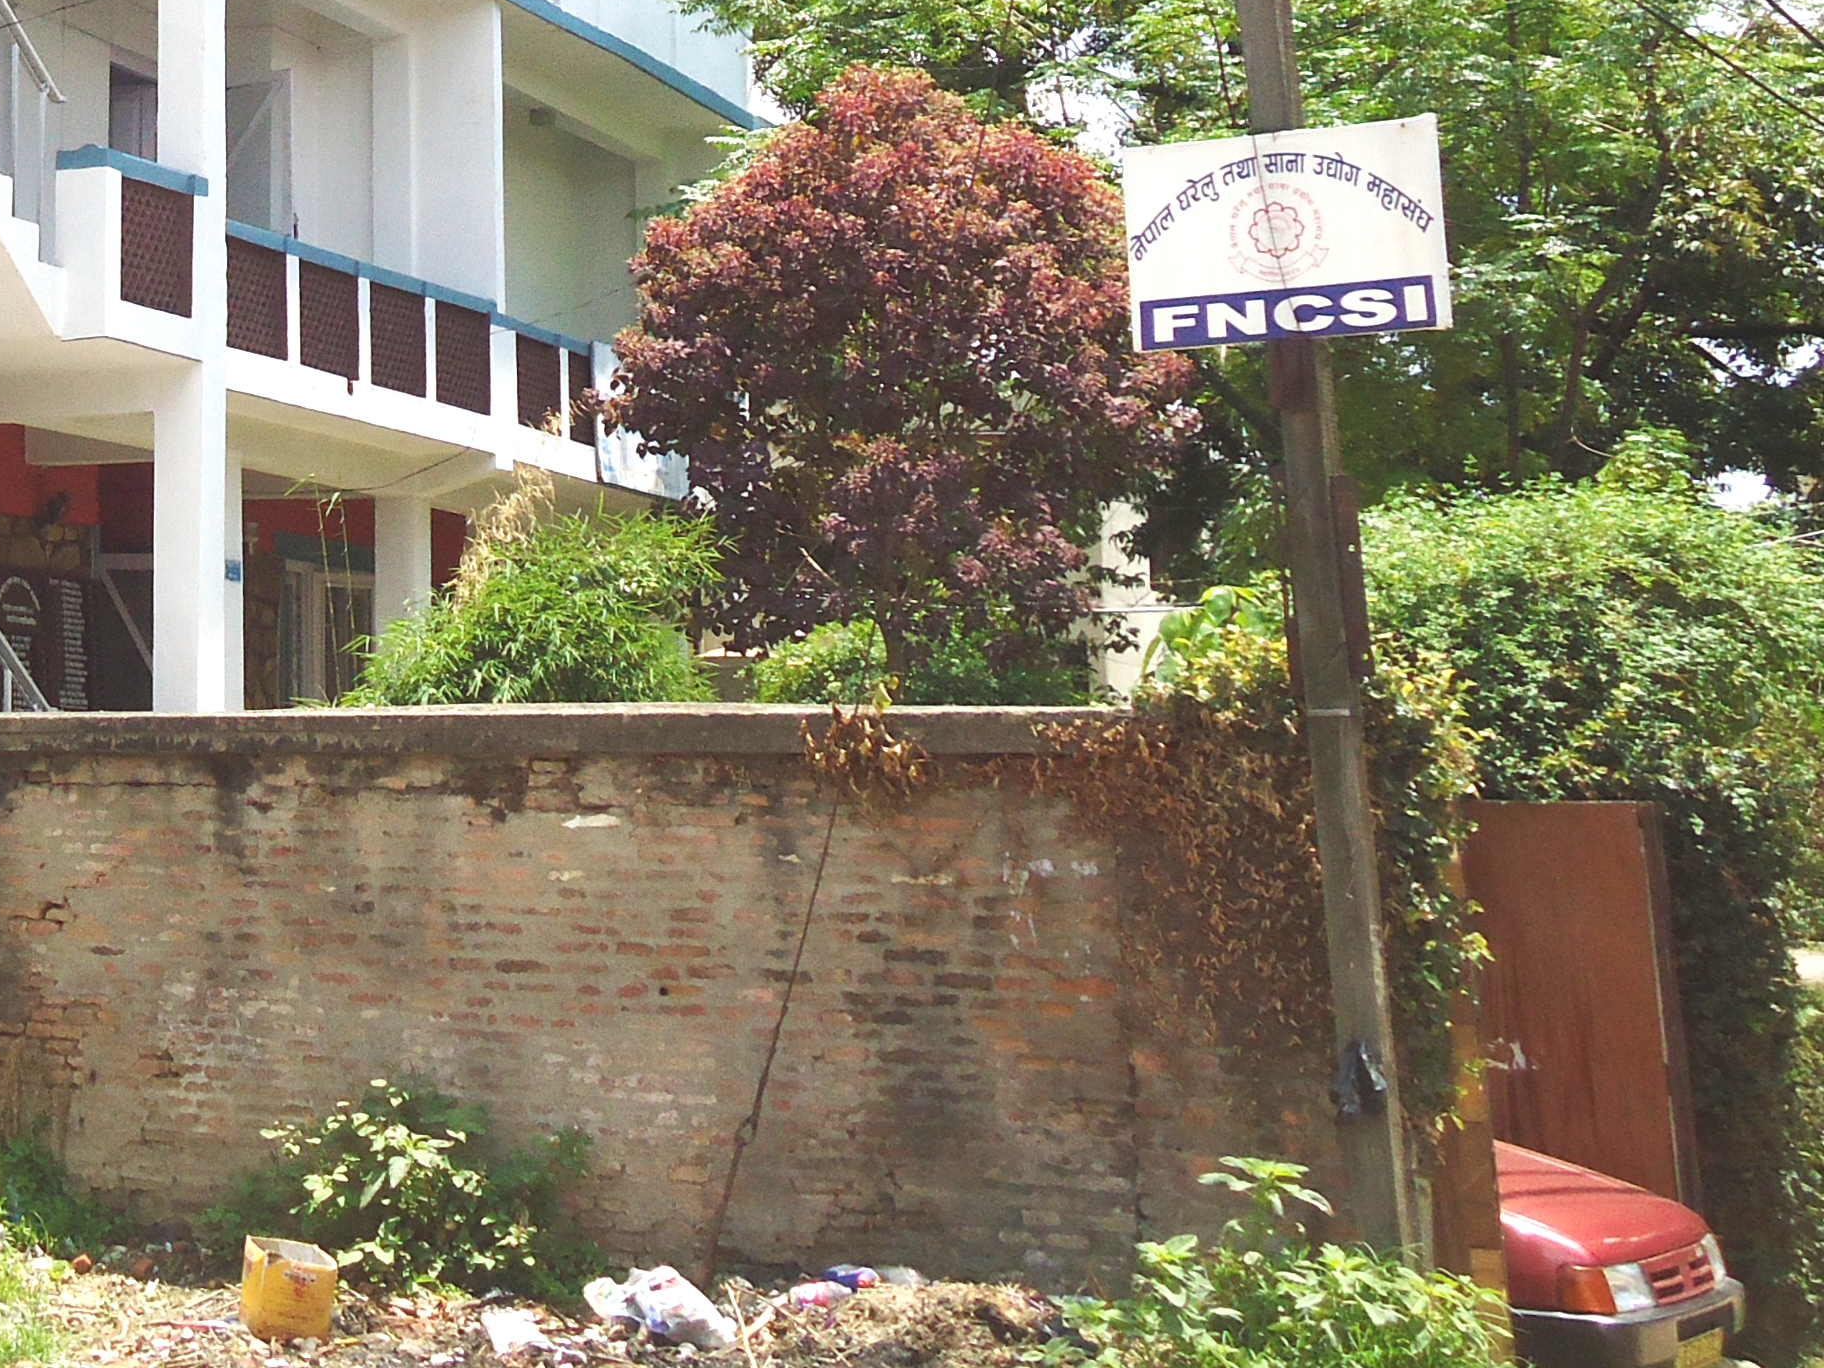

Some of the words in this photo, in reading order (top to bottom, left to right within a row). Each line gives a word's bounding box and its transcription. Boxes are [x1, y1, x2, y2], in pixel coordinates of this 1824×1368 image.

[1129, 203, 1175, 261] नेपाल
[1175, 171, 1220, 211] घरेलु
[1219, 156, 1257, 186] तथा
[1262, 152, 1307, 174] साना
[1312, 151, 1362, 186] उद्योग
[1366, 172, 1434, 233] महासंघ
[1152, 284, 1428, 343] FNCSI
